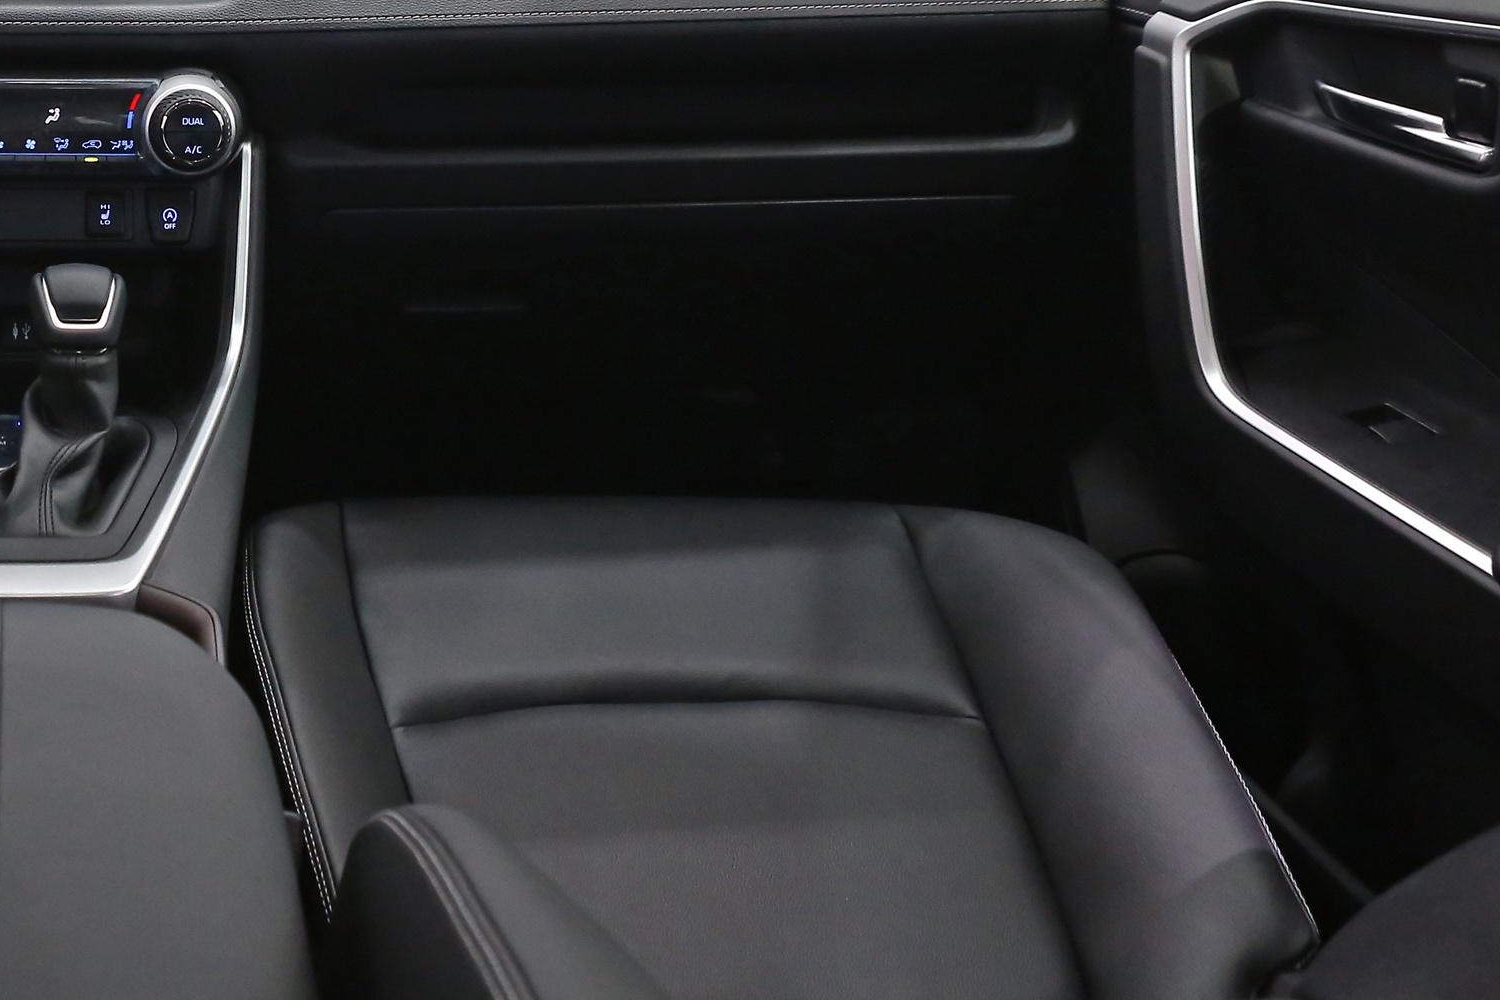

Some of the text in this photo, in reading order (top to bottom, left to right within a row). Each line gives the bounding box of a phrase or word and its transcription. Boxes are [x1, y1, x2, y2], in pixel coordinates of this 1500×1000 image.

[181, 117, 204, 126] DUAL
[184, 145, 202, 154] A/C
[164, 222, 176, 230] OFF
